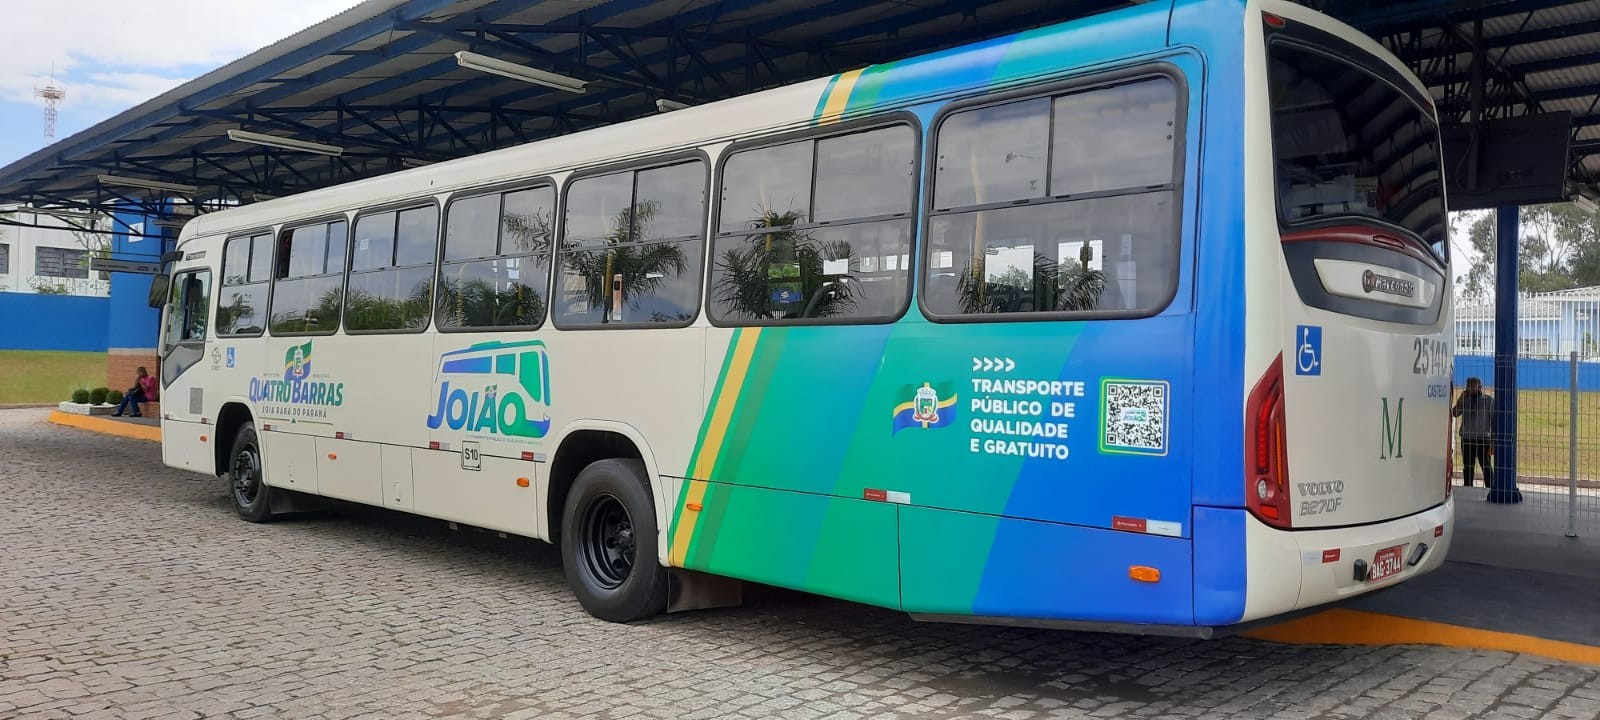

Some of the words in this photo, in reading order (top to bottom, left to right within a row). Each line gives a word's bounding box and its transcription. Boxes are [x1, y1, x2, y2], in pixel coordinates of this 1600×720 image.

[1413, 337, 1448, 376] 25140
[248, 376, 292, 404] QUATRO
[291, 379, 344, 407] BARRAS
[971, 379, 1085, 397] TRANSPORTE
[292, 407, 301, 417] DO
[302, 407, 327, 418] PARANÁ
[427, 381, 528, 437] JOIÃO
[971, 395, 1042, 416] PÚBLICO
[1051, 402, 1075, 418] DE
[970, 418, 1068, 439] QUALIDADE
[1379, 397, 1405, 460] M
[464, 448, 479, 461] S10
[970, 438, 980, 453] E
[984, 440, 1069, 460] GRATUITO
[1297, 480, 1345, 497] VOLVO
